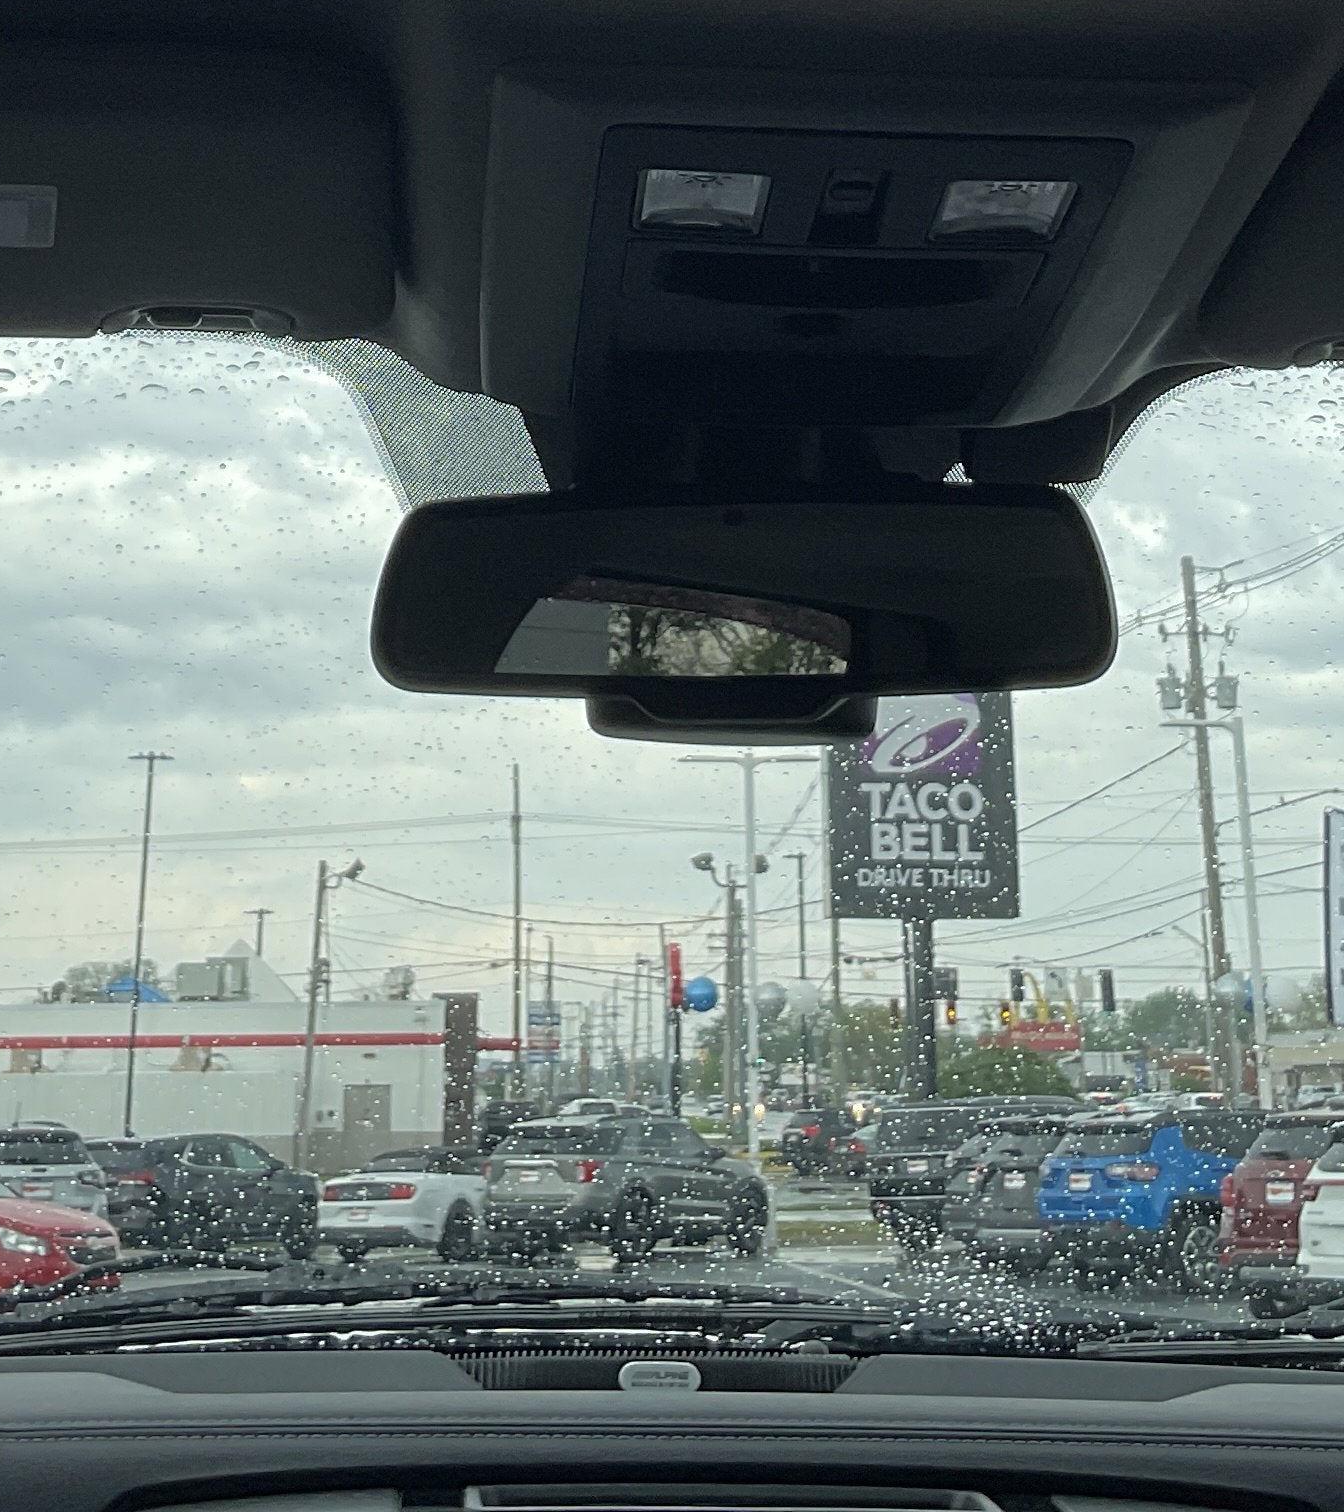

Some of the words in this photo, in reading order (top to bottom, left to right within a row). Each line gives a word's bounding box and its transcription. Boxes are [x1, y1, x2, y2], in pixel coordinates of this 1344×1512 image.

[860, 782, 984, 820] TACO
[870, 823, 985, 861] BELL
[857, 867, 925, 887] DRIVE
[927, 867, 992, 888] THRU
